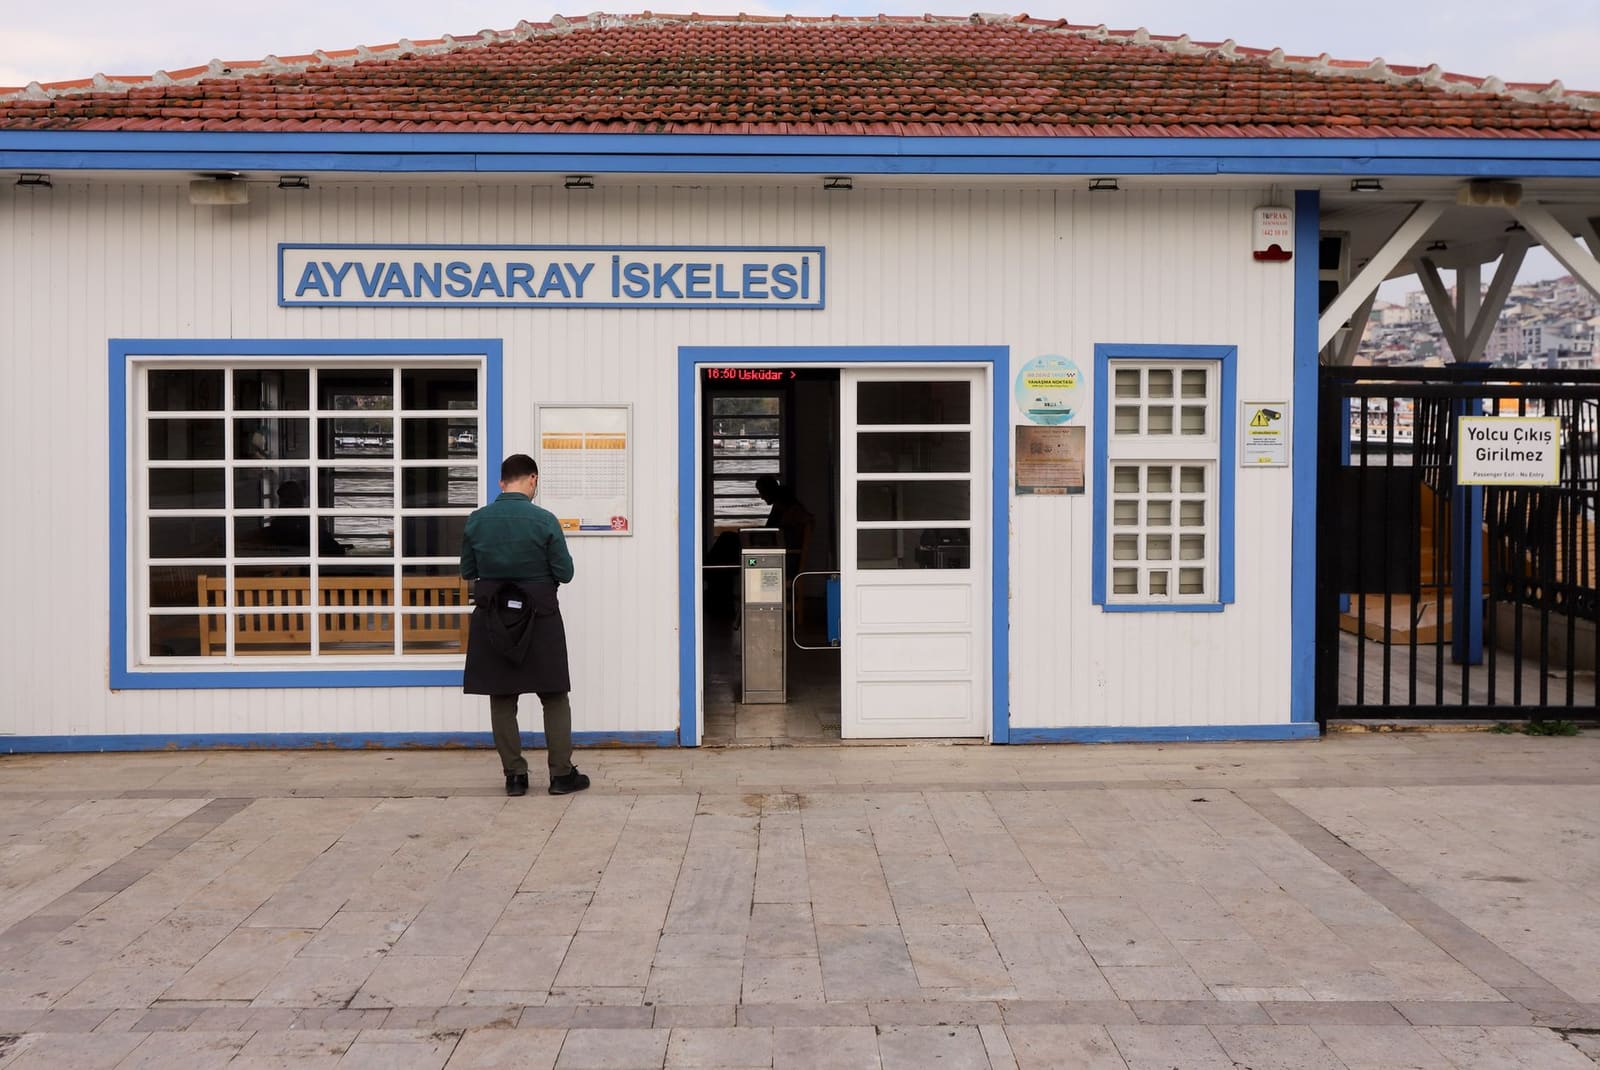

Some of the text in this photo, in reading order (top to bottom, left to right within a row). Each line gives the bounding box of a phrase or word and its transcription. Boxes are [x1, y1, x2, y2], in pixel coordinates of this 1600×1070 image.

[295, 255, 809, 299] AYVANSARAY İSKELESİ
[1467, 427, 1552, 445] Yolcu Çıkış
[1476, 448, 1544, 462] Girilmez
